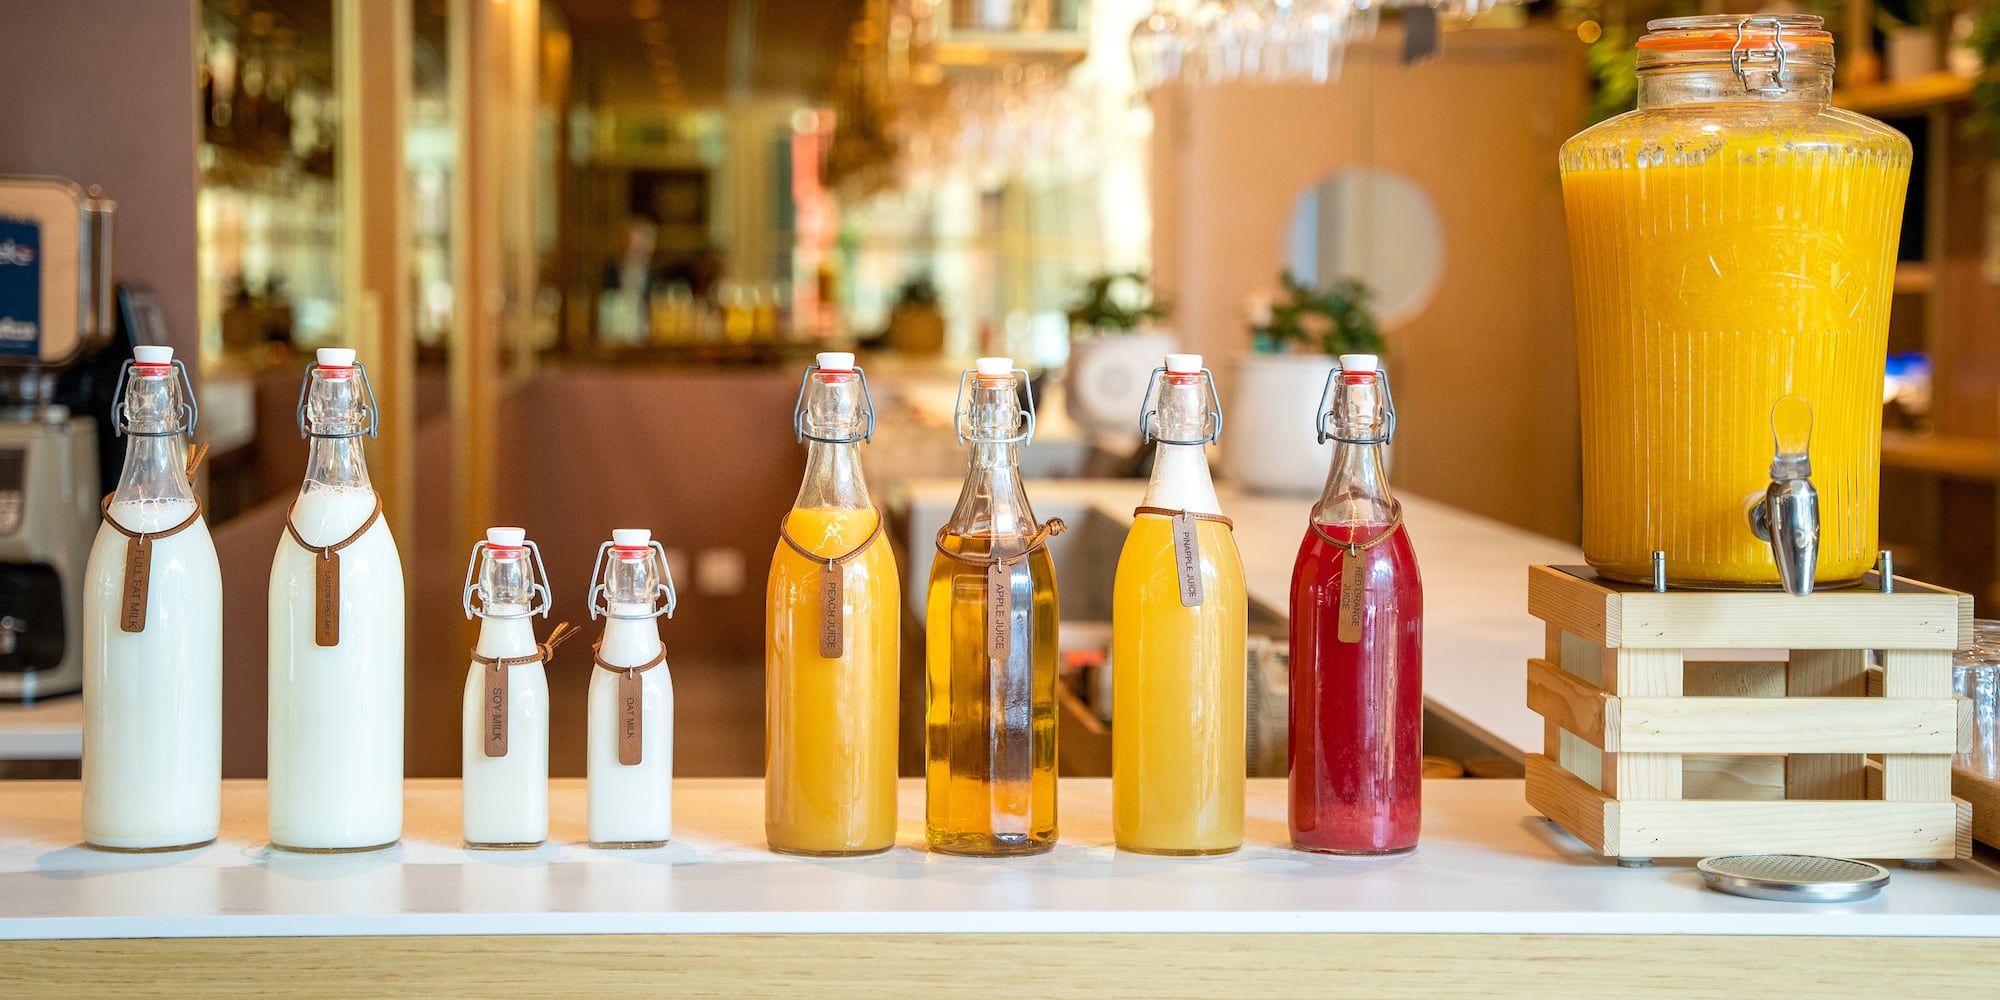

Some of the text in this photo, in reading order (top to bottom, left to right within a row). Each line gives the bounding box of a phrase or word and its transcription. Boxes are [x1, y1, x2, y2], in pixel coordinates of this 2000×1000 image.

[128, 550, 145, 629] FULL FAT MILK
[1183, 531, 1197, 598] PINAPPLE JUICE
[827, 582, 836, 649] PEACH JUICE
[995, 583, 1005, 649] APPLE JUICE
[1342, 583, 1351, 610] JUICE
[1351, 566, 1363, 627] RED ORANGE
[492, 687, 502, 741] SOY MILK
[626, 697, 635, 739] OAT MILK
